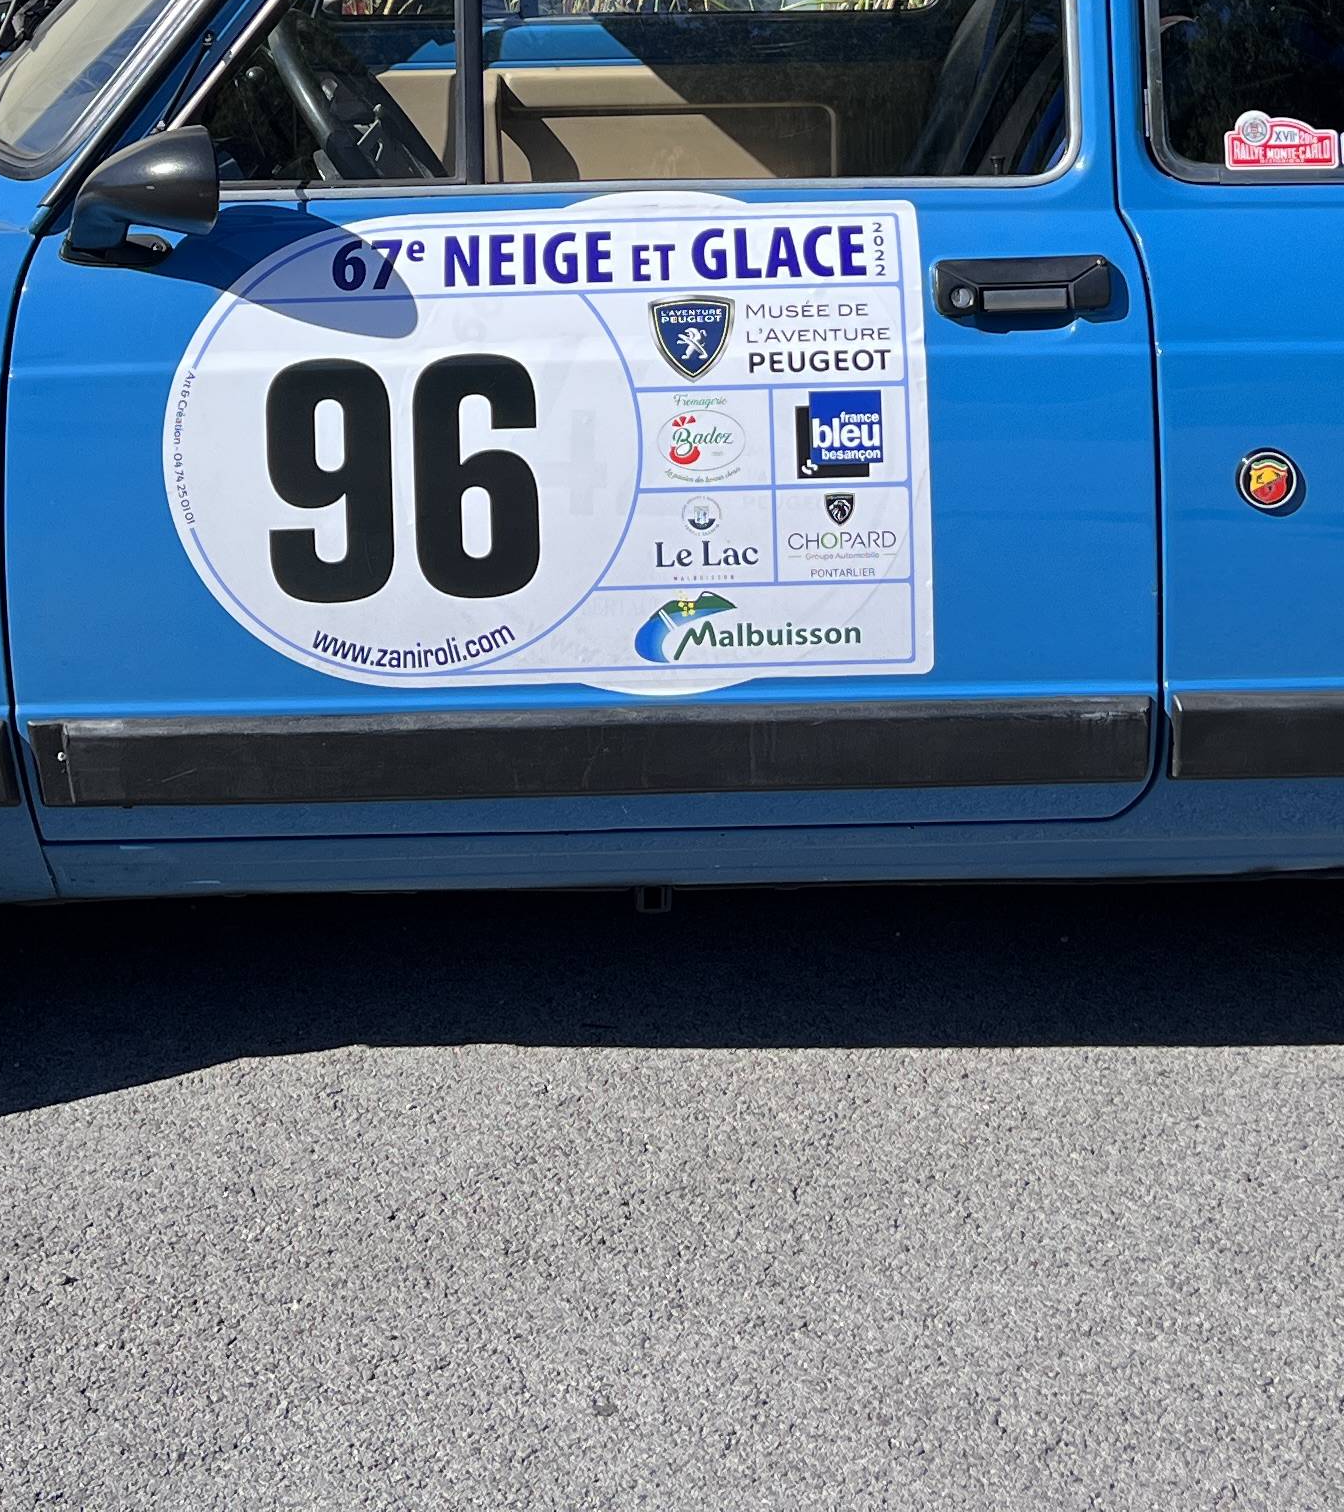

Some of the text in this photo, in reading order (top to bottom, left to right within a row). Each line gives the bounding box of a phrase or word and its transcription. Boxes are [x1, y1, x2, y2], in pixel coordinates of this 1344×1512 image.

[1233, 139, 1330, 160] RALLYE MONTE-CARLO
[331, 225, 868, 291] 67e NEIGE ET GLACE
[871, 221, 886, 277] 2022
[660, 314, 722, 324] PEUGEOT
[745, 299, 869, 320] MUSÉE DE
[745, 327, 891, 344] L'AVENTURE
[748, 348, 892, 374] PEUGEOT
[839, 411, 880, 423] france
[672, 426, 734, 457] Badoz
[812, 417, 881, 448] bleu
[821, 448, 881, 462] besançon
[265, 353, 541, 603] 96
[787, 530, 897, 550] CHOPARD
[655, 540, 760, 567] Le Lac
[810, 567, 876, 579] PONTARLIER
[312, 624, 516, 670] www.zaniroli.com
[673, 621, 861, 661] Malbuisson
